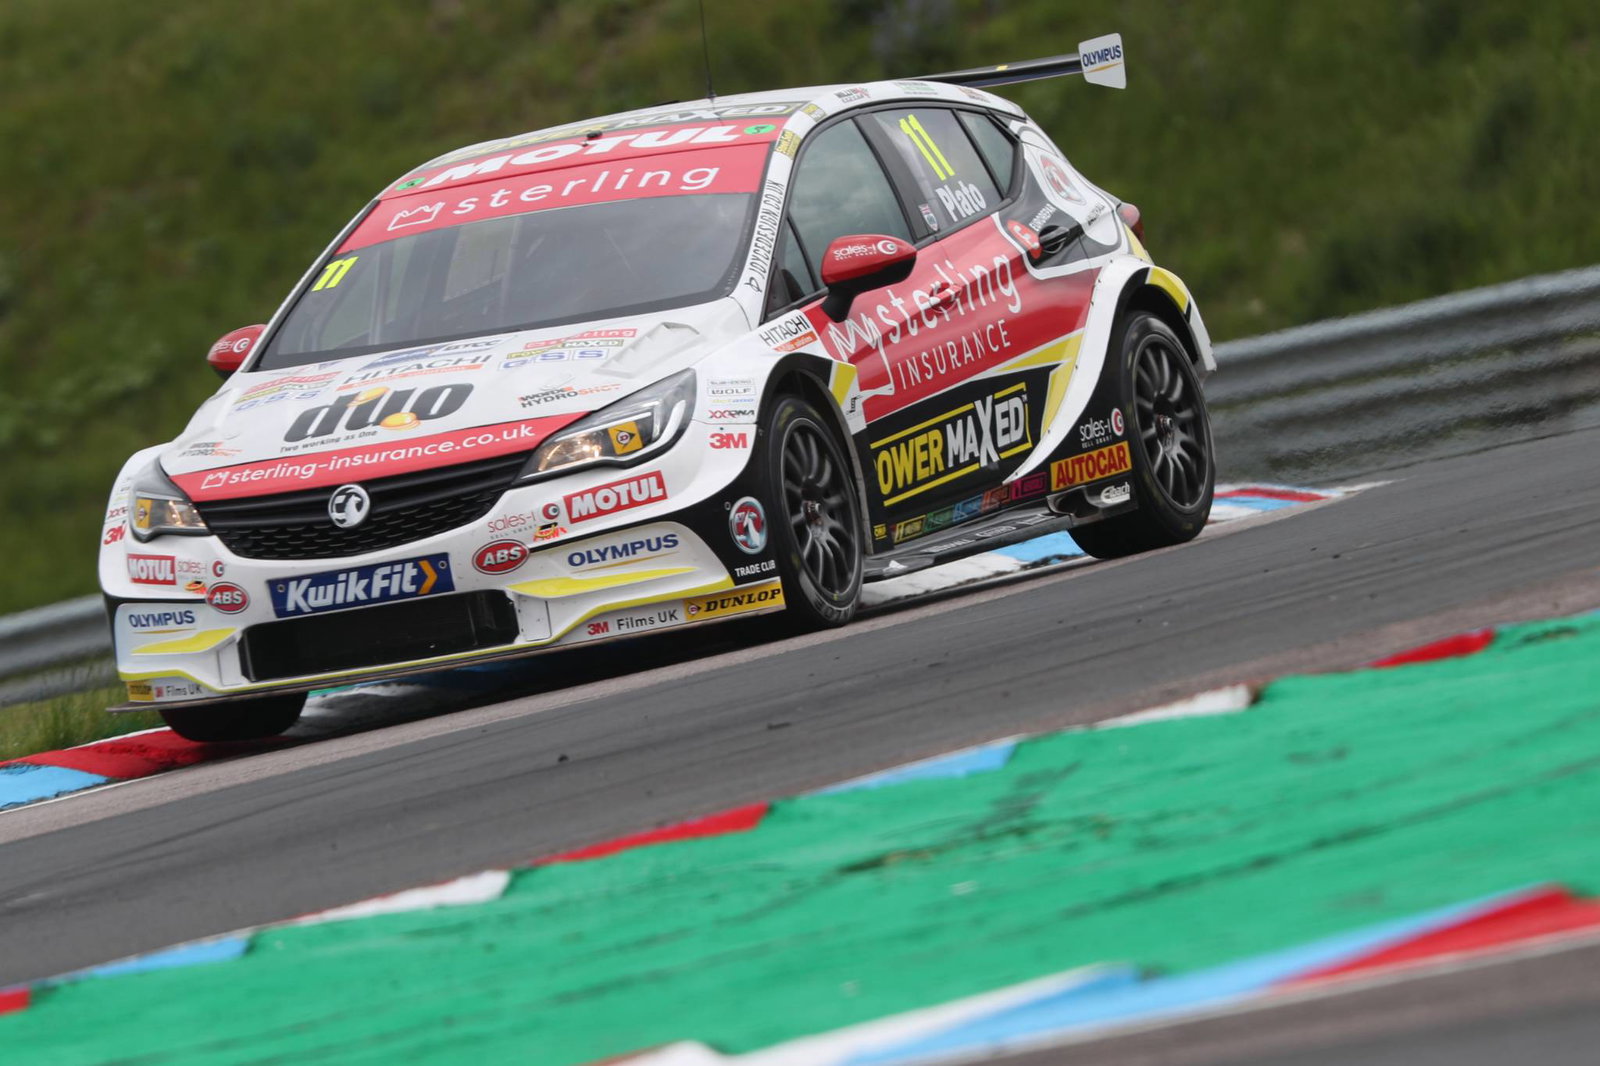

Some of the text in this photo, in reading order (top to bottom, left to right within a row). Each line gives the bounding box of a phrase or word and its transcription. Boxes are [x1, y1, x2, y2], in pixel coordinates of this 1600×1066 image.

[1082, 45, 1122, 67] OLYMPUS
[421, 125, 742, 188] MOTUL
[900, 114, 955, 181] 11
[453, 167, 720, 214] sterling
[935, 181, 987, 223] Plato
[755, 179, 785, 280] JOYCEDESIGN.CO.UK
[312, 256, 359, 292] 11
[872, 255, 1022, 345] sterling
[759, 314, 811, 347] HITACHI
[344, 355, 493, 384] HITACHI
[897, 319, 1012, 390] INSURANCE
[283, 383, 474, 443] duo
[228, 424, 535, 485] sterling-insurance.co.uk
[279, 446, 299, 454] Two
[301, 435, 341, 451] working
[709, 432, 748, 449] 3M
[874, 394, 1027, 497] OWER MAXED
[1055, 445, 1129, 491] AUTOCAR
[571, 477, 664, 517] MOTUL
[1101, 481, 1131, 504] Eibach
[482, 546, 523, 567] ABS
[567, 533, 680, 568] OLYMPUS
[735, 559, 777, 577] TRADE CLUB
[128, 558, 176, 581] MOTUL
[212, 590, 243, 605] ABS
[705, 588, 781, 613] DUNLOP
[128, 610, 196, 628] OLYMPUS
[587, 608, 679, 636] 3M Films UK
